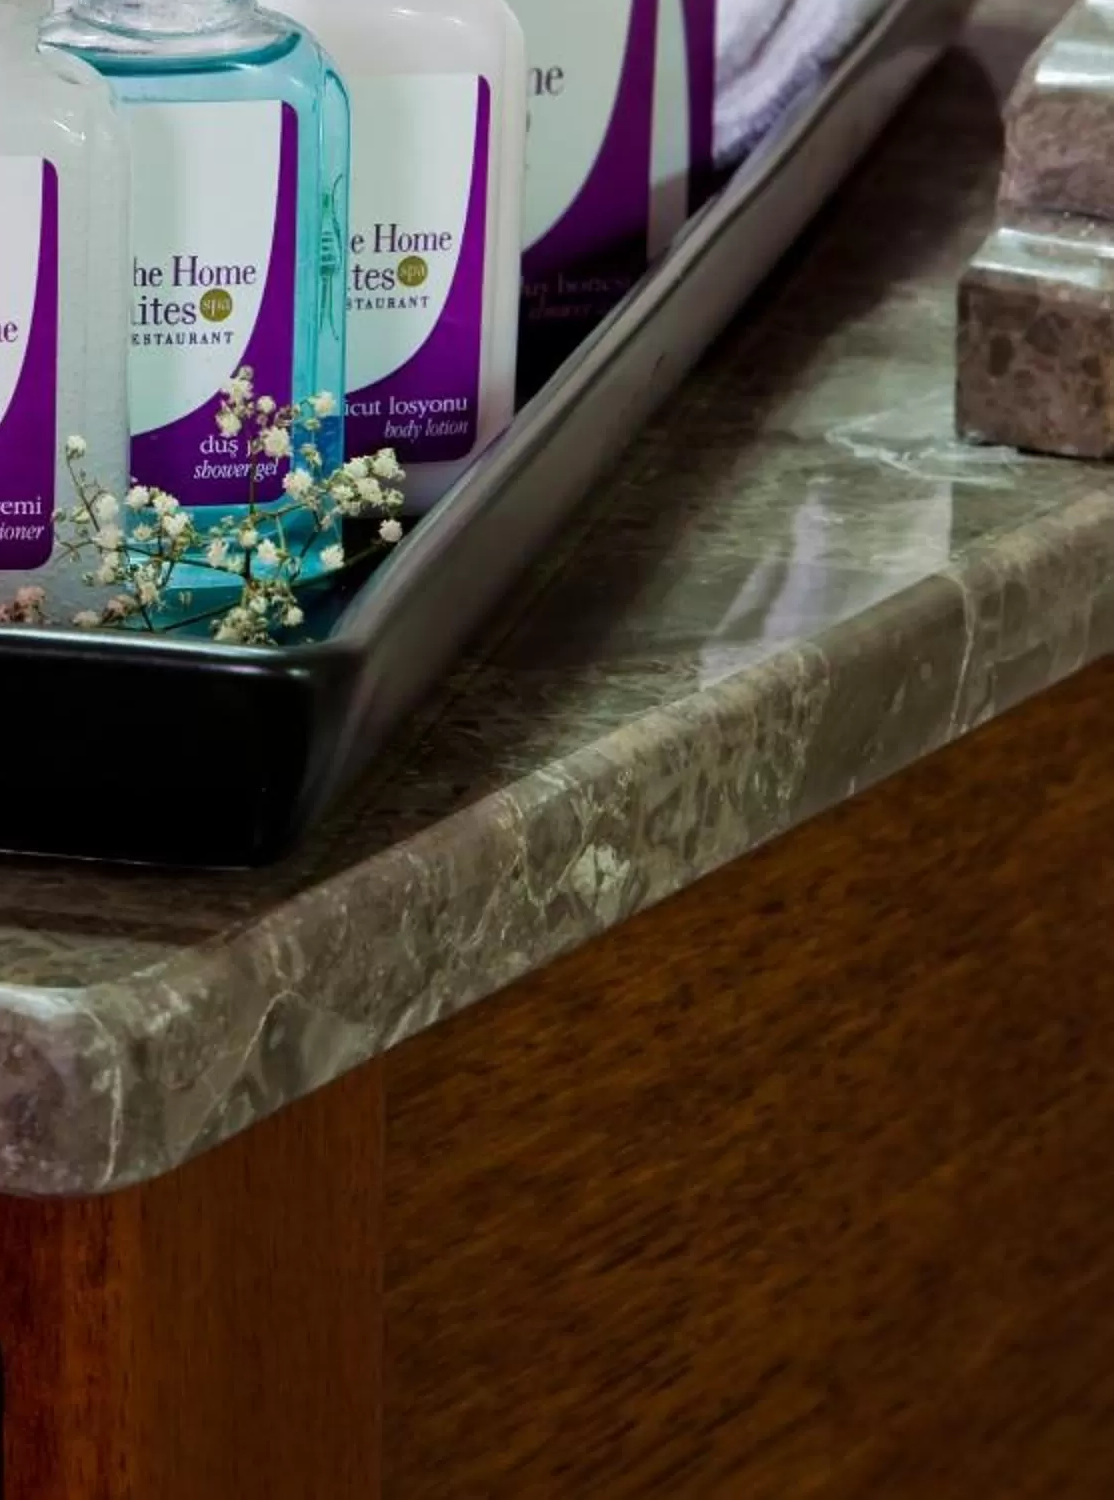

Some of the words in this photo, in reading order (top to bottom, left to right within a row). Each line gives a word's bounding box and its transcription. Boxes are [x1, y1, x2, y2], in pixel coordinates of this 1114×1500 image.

[374, 223, 452, 252] Home
[133, 256, 163, 287] he
[172, 255, 257, 287] Home
[351, 264, 396, 291] tes
[134, 295, 197, 326] ites
[131, 331, 235, 346] ESTAURANT
[389, 396, 468, 418] losyonu
[384, 419, 422, 443] body
[425, 418, 469, 437] lotion
[193, 460, 252, 479] shower
